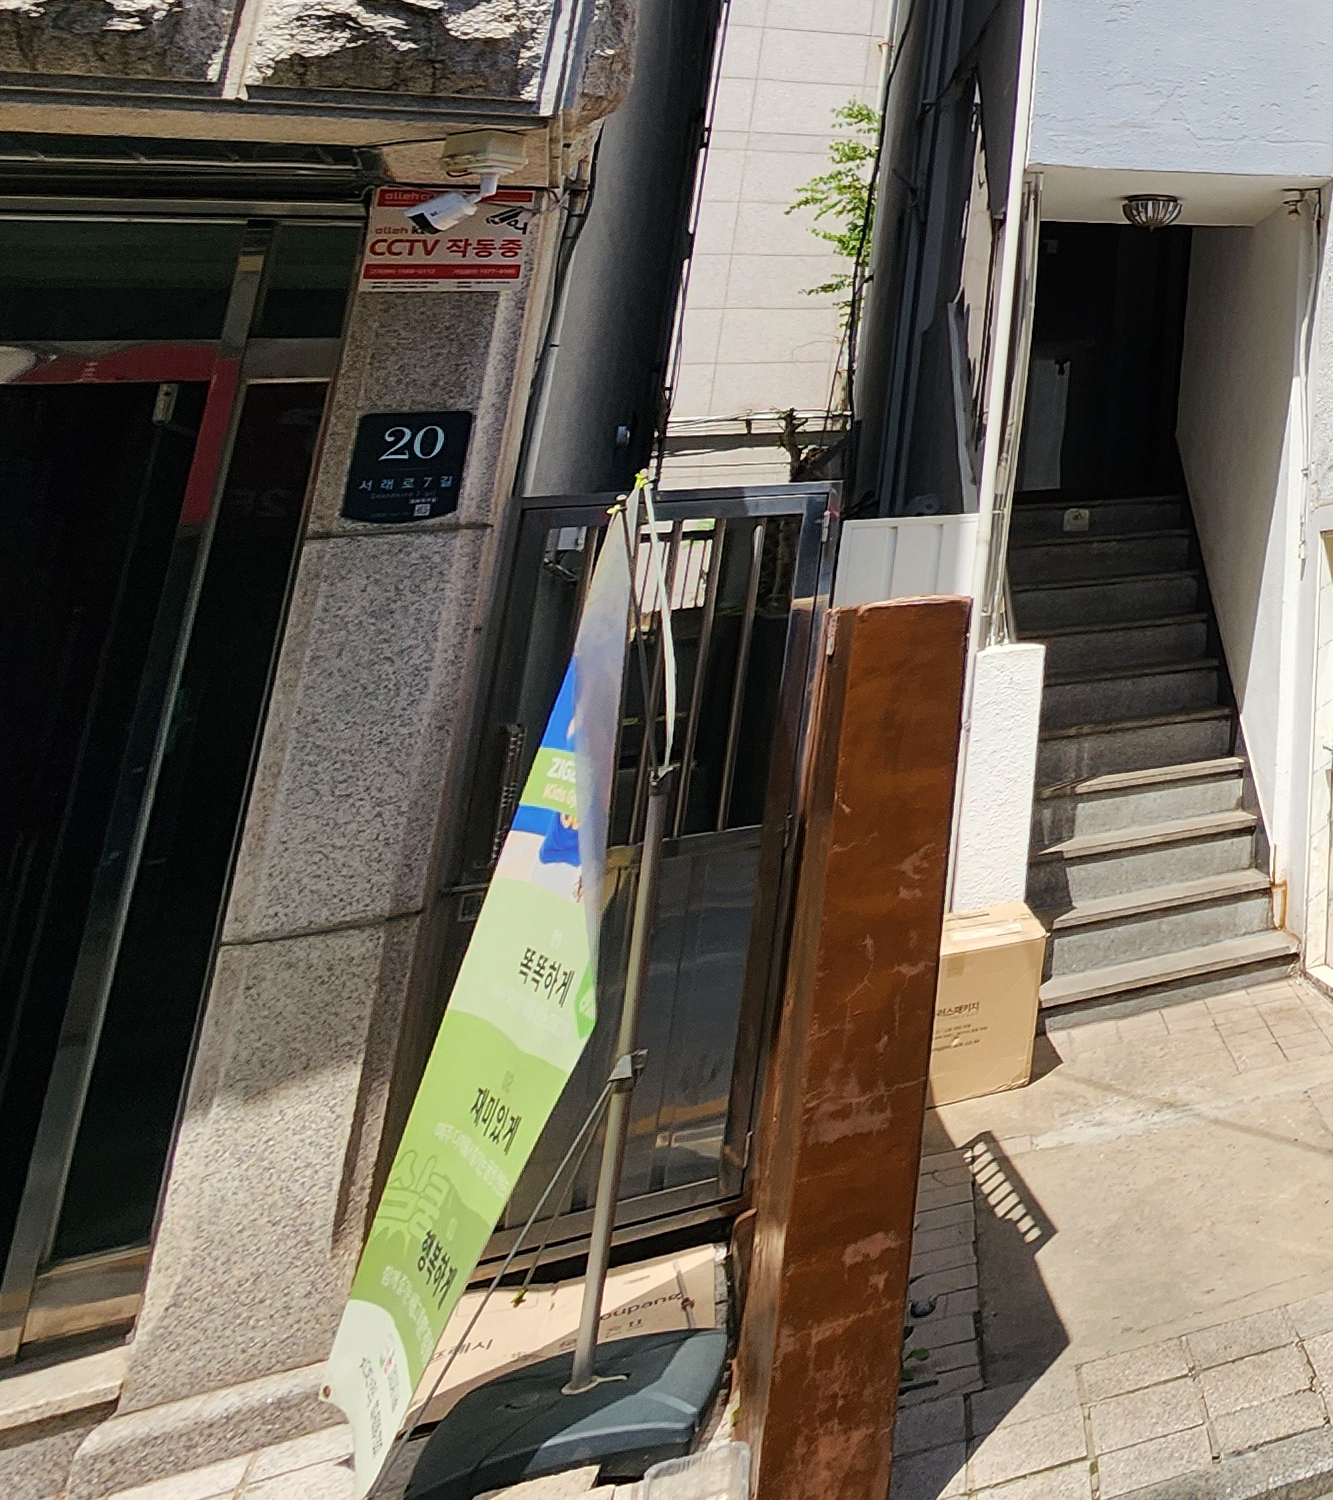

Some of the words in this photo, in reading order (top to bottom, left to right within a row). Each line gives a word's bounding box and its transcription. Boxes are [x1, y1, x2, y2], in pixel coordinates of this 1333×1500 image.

[369, 238, 441, 256] CCTV
[446, 238, 522, 258] 작동중
[378, 425, 445, 460] 20
[518, 946, 574, 1008] 똑똑하게
[471, 1087, 522, 1156] 재미있게
[417, 1229, 458, 1311] 행복하게
